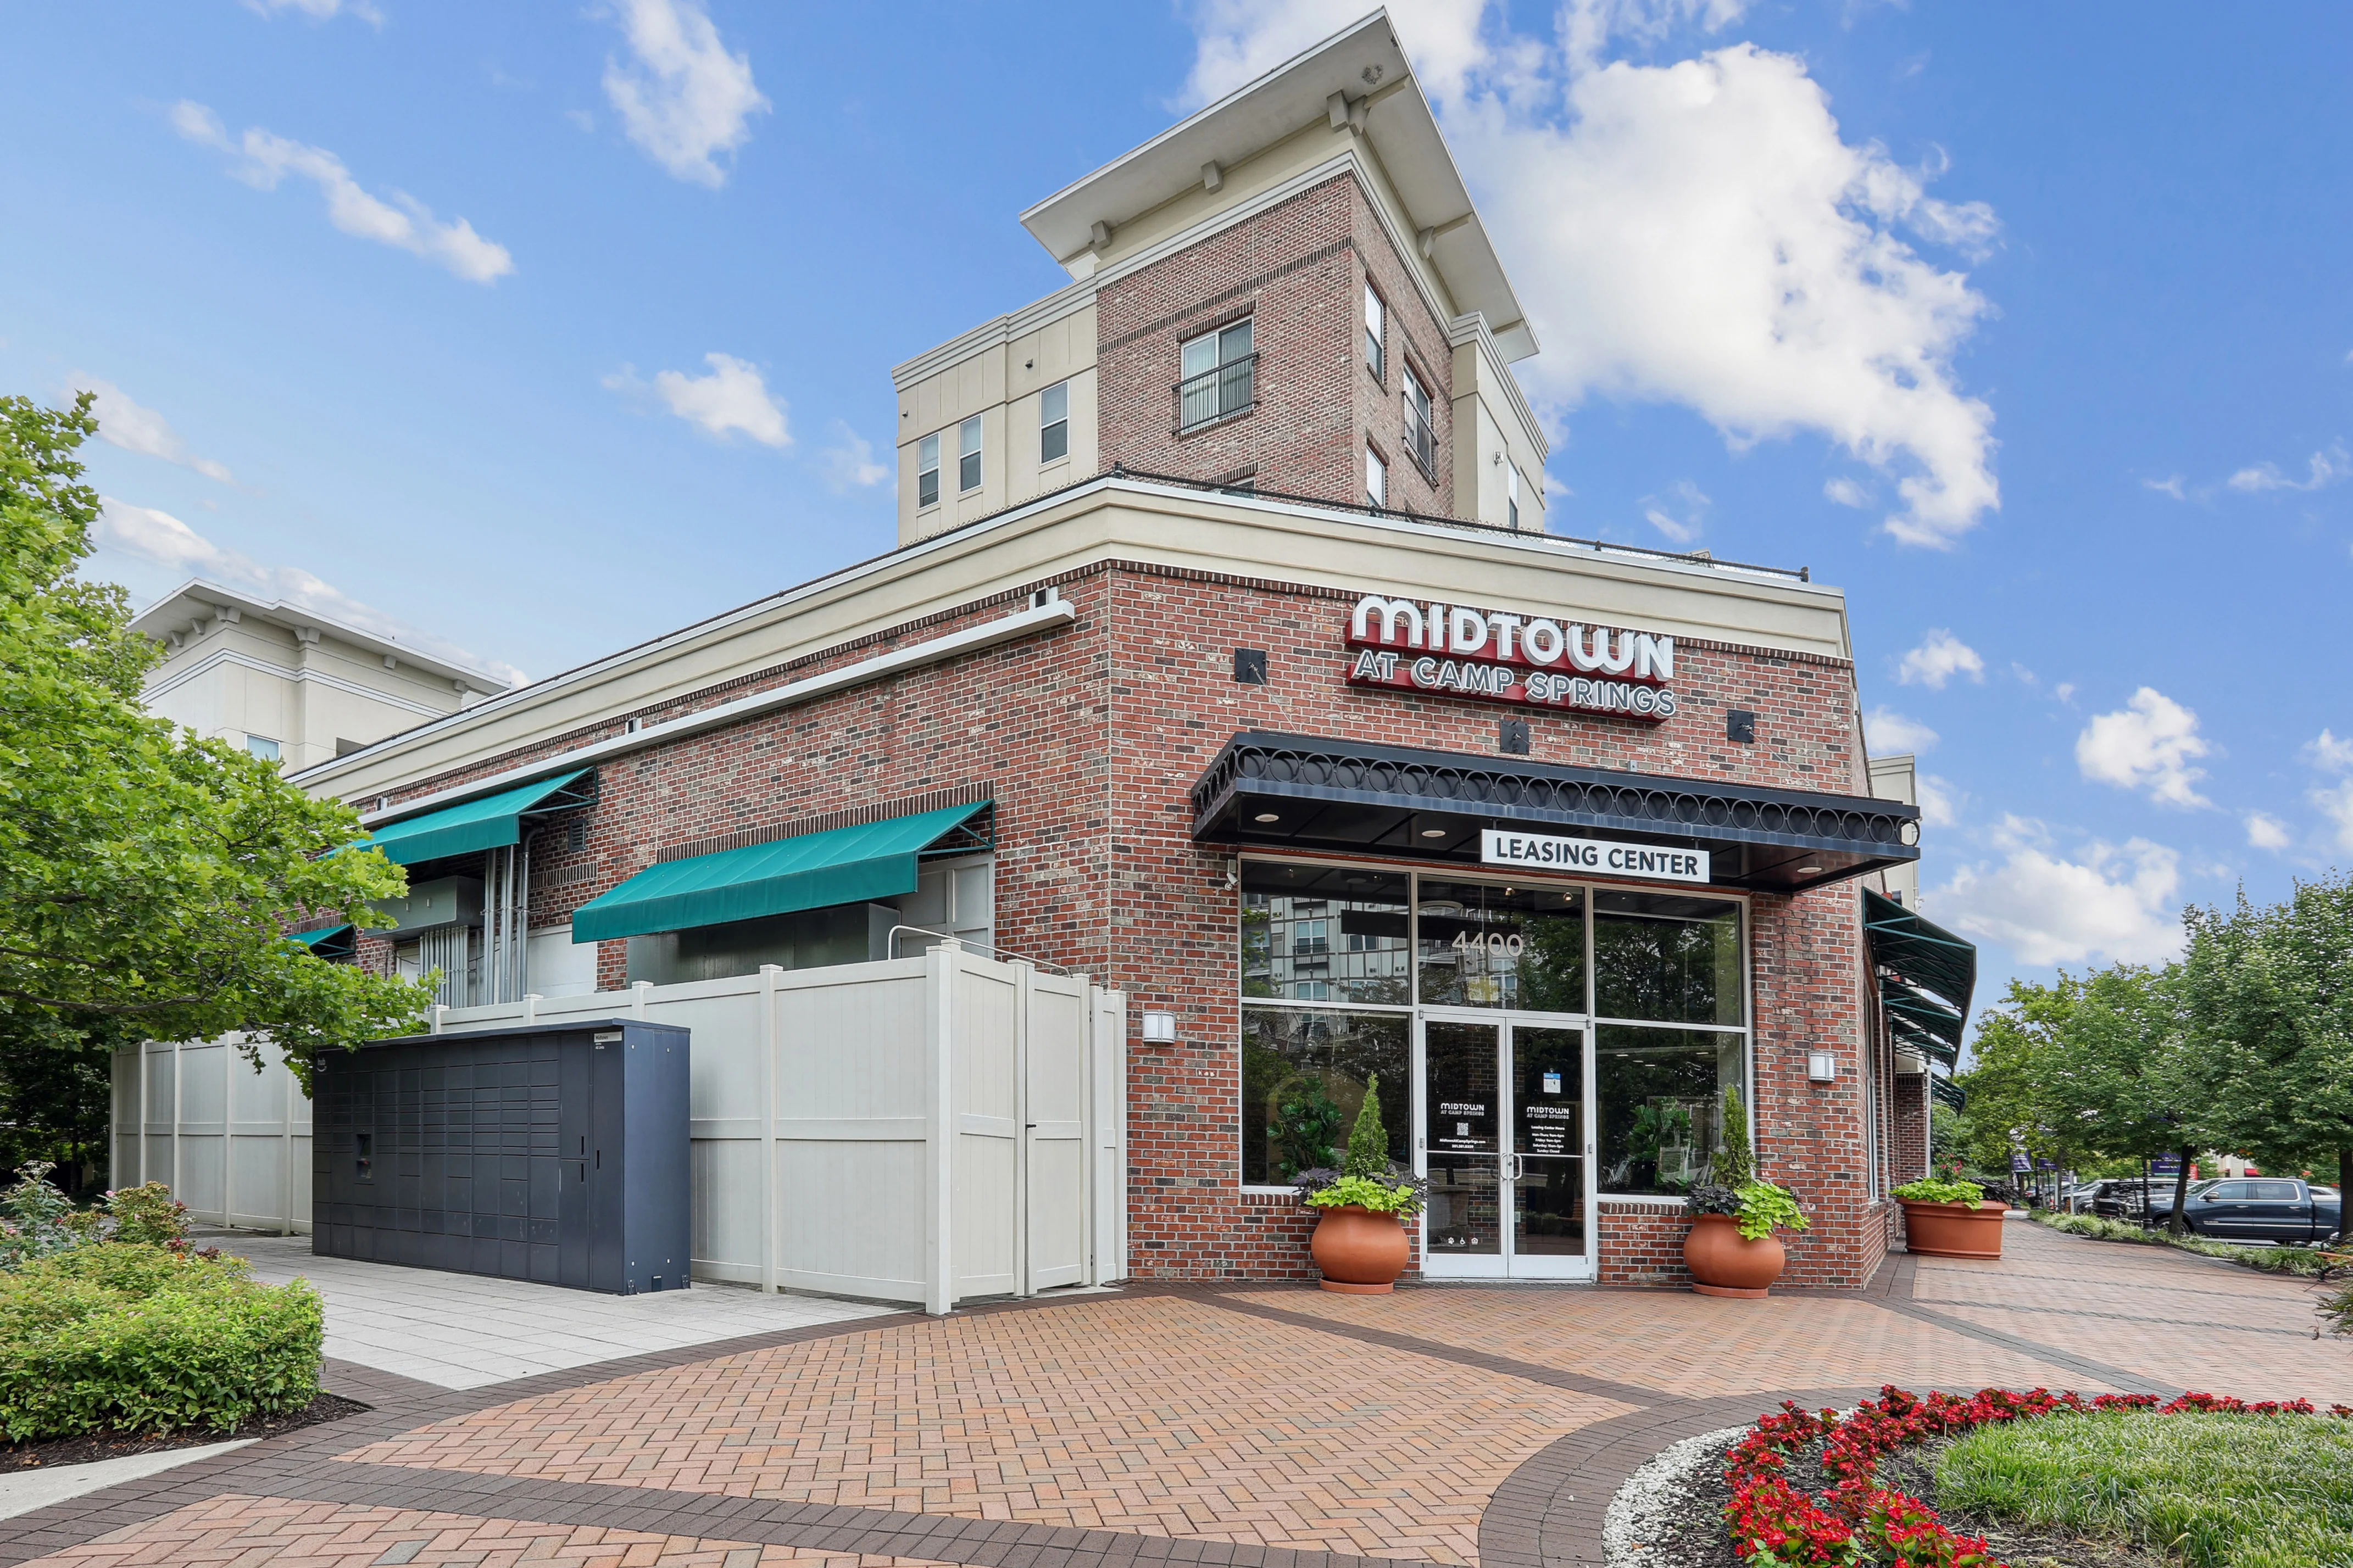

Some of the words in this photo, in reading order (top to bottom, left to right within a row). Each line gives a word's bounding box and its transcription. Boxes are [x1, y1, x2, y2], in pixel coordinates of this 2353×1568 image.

[1352, 595, 1673, 681] MIDTOWN
[1354, 649, 1398, 681] AT
[1411, 657, 1515, 696] CAMP
[1526, 672, 1676, 718] SPRINGS
[1497, 838, 1598, 866] LEASING
[1609, 849, 1698, 875] CENTER
[1451, 930, 1524, 957] 4400
[1440, 1103, 1484, 1111] MIDTOWN
[1527, 1106, 1569, 1114] MIDTOWN
